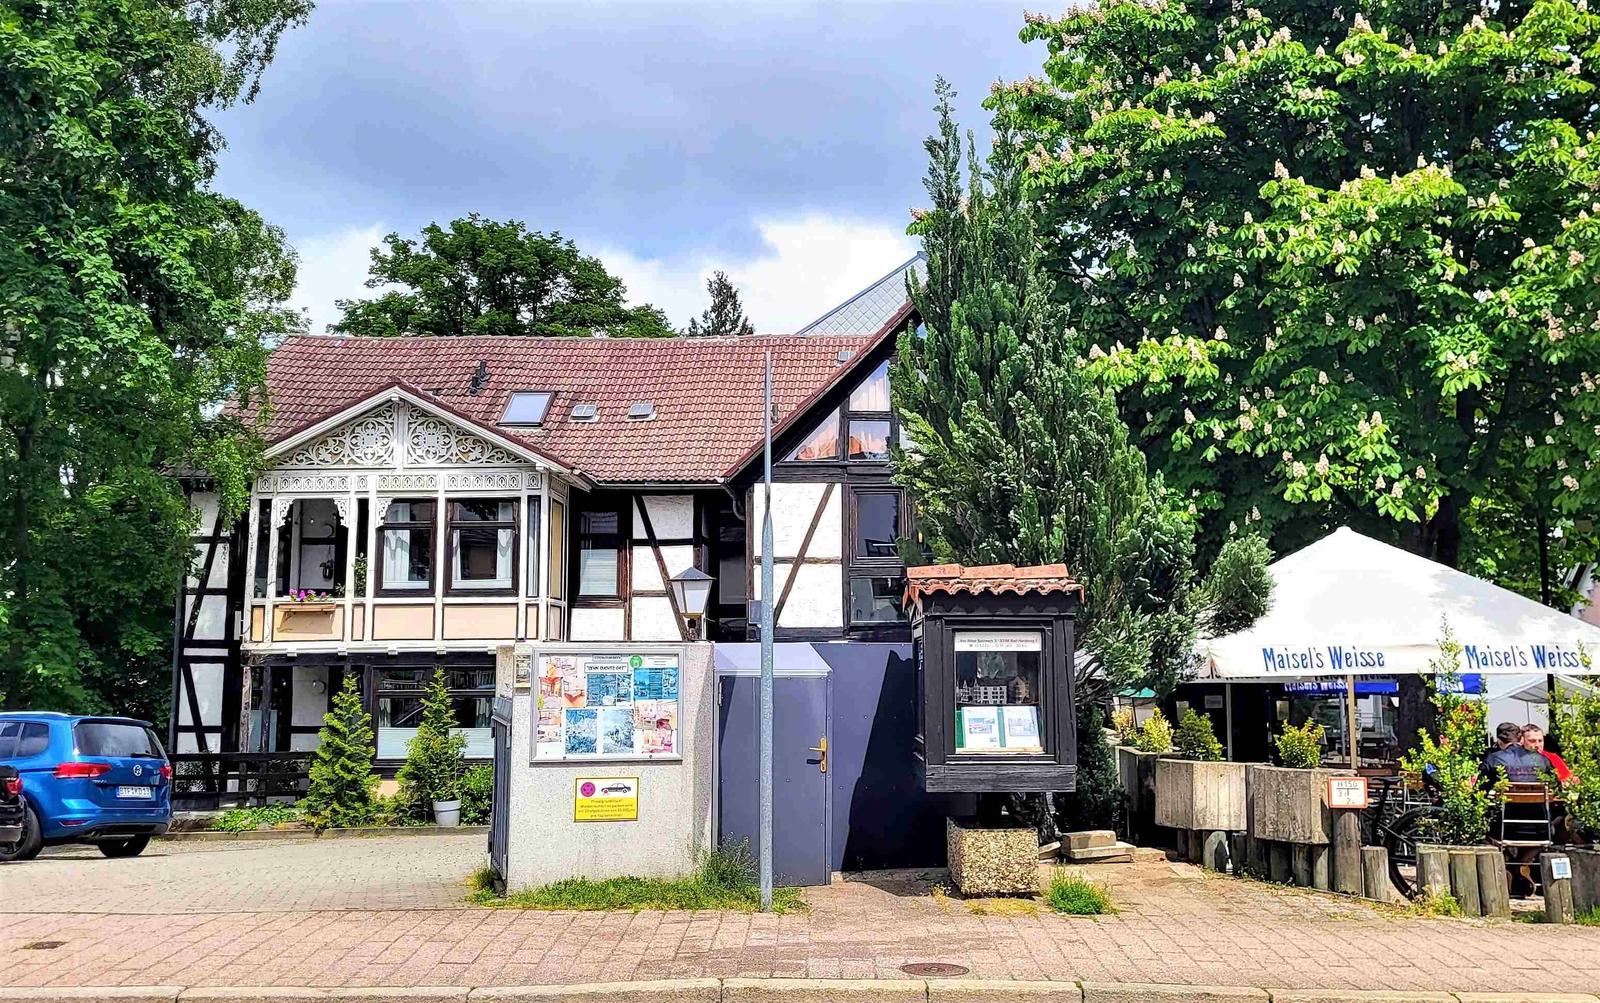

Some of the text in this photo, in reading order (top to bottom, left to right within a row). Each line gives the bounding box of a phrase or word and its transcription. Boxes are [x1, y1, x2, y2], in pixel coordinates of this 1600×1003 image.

[1262, 645, 1385, 671] Maisel's Weisse
[1464, 645, 1528, 669] Maisel's
